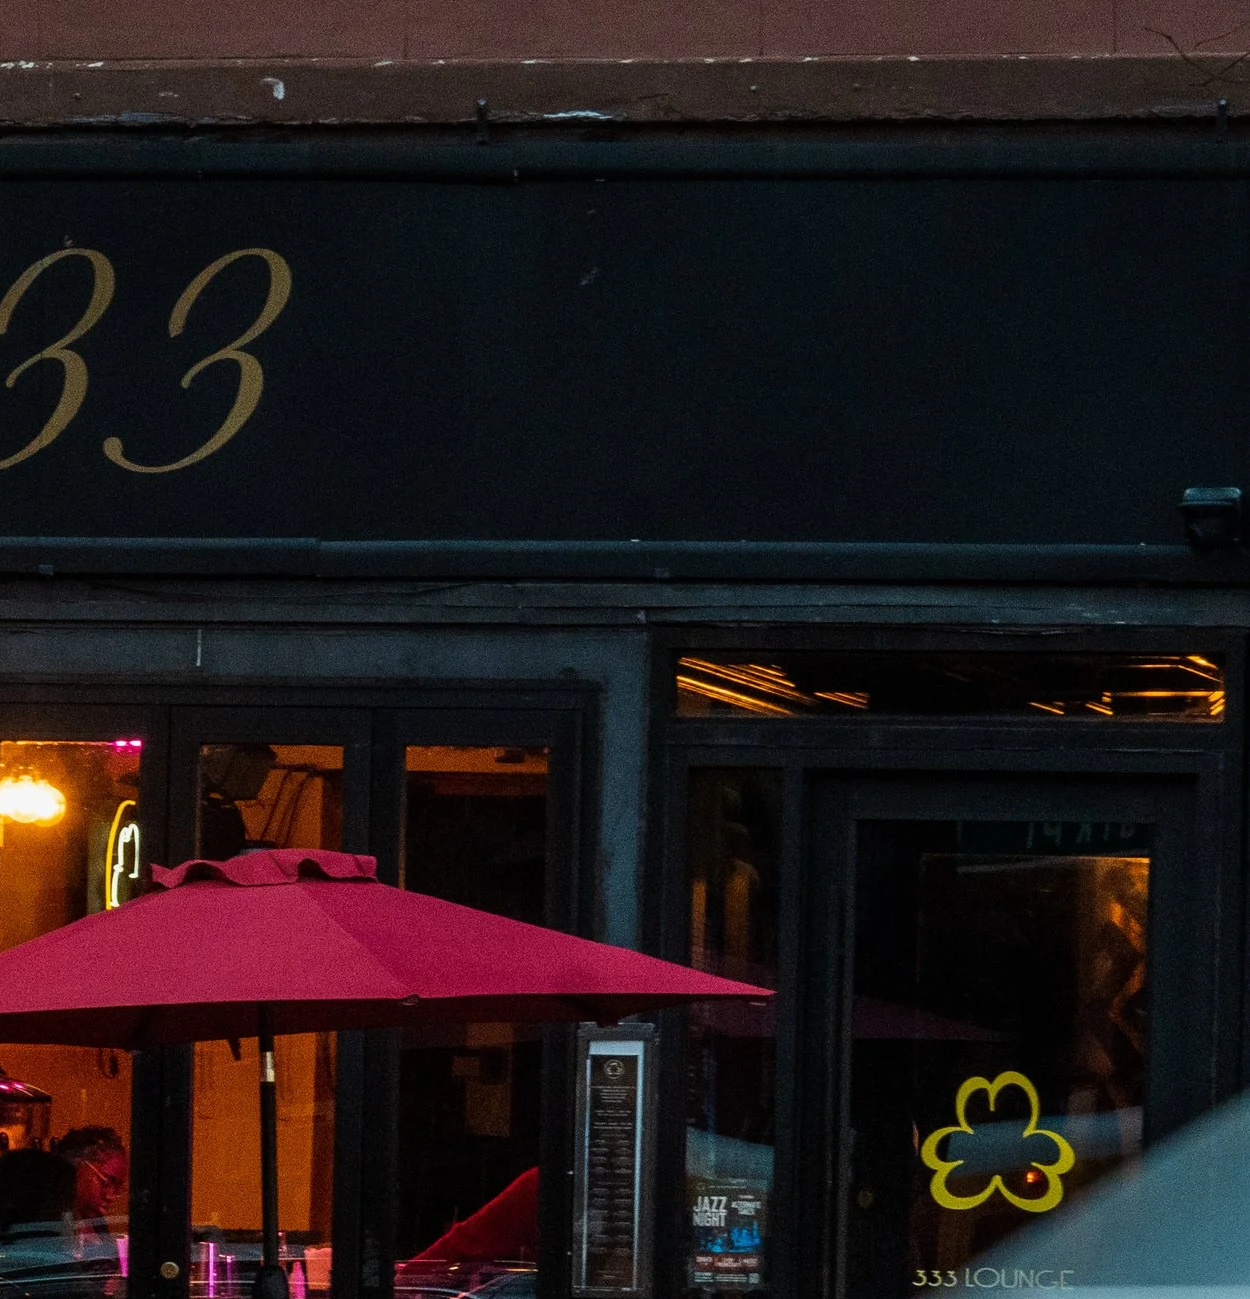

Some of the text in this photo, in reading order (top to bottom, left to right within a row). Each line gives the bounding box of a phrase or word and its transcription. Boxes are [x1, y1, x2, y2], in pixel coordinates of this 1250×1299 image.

[693, 1196, 727, 1212] JAZZ
[693, 1212, 727, 1227] NIGHT
[912, 1267, 1075, 1290] 333 LOUNGE
